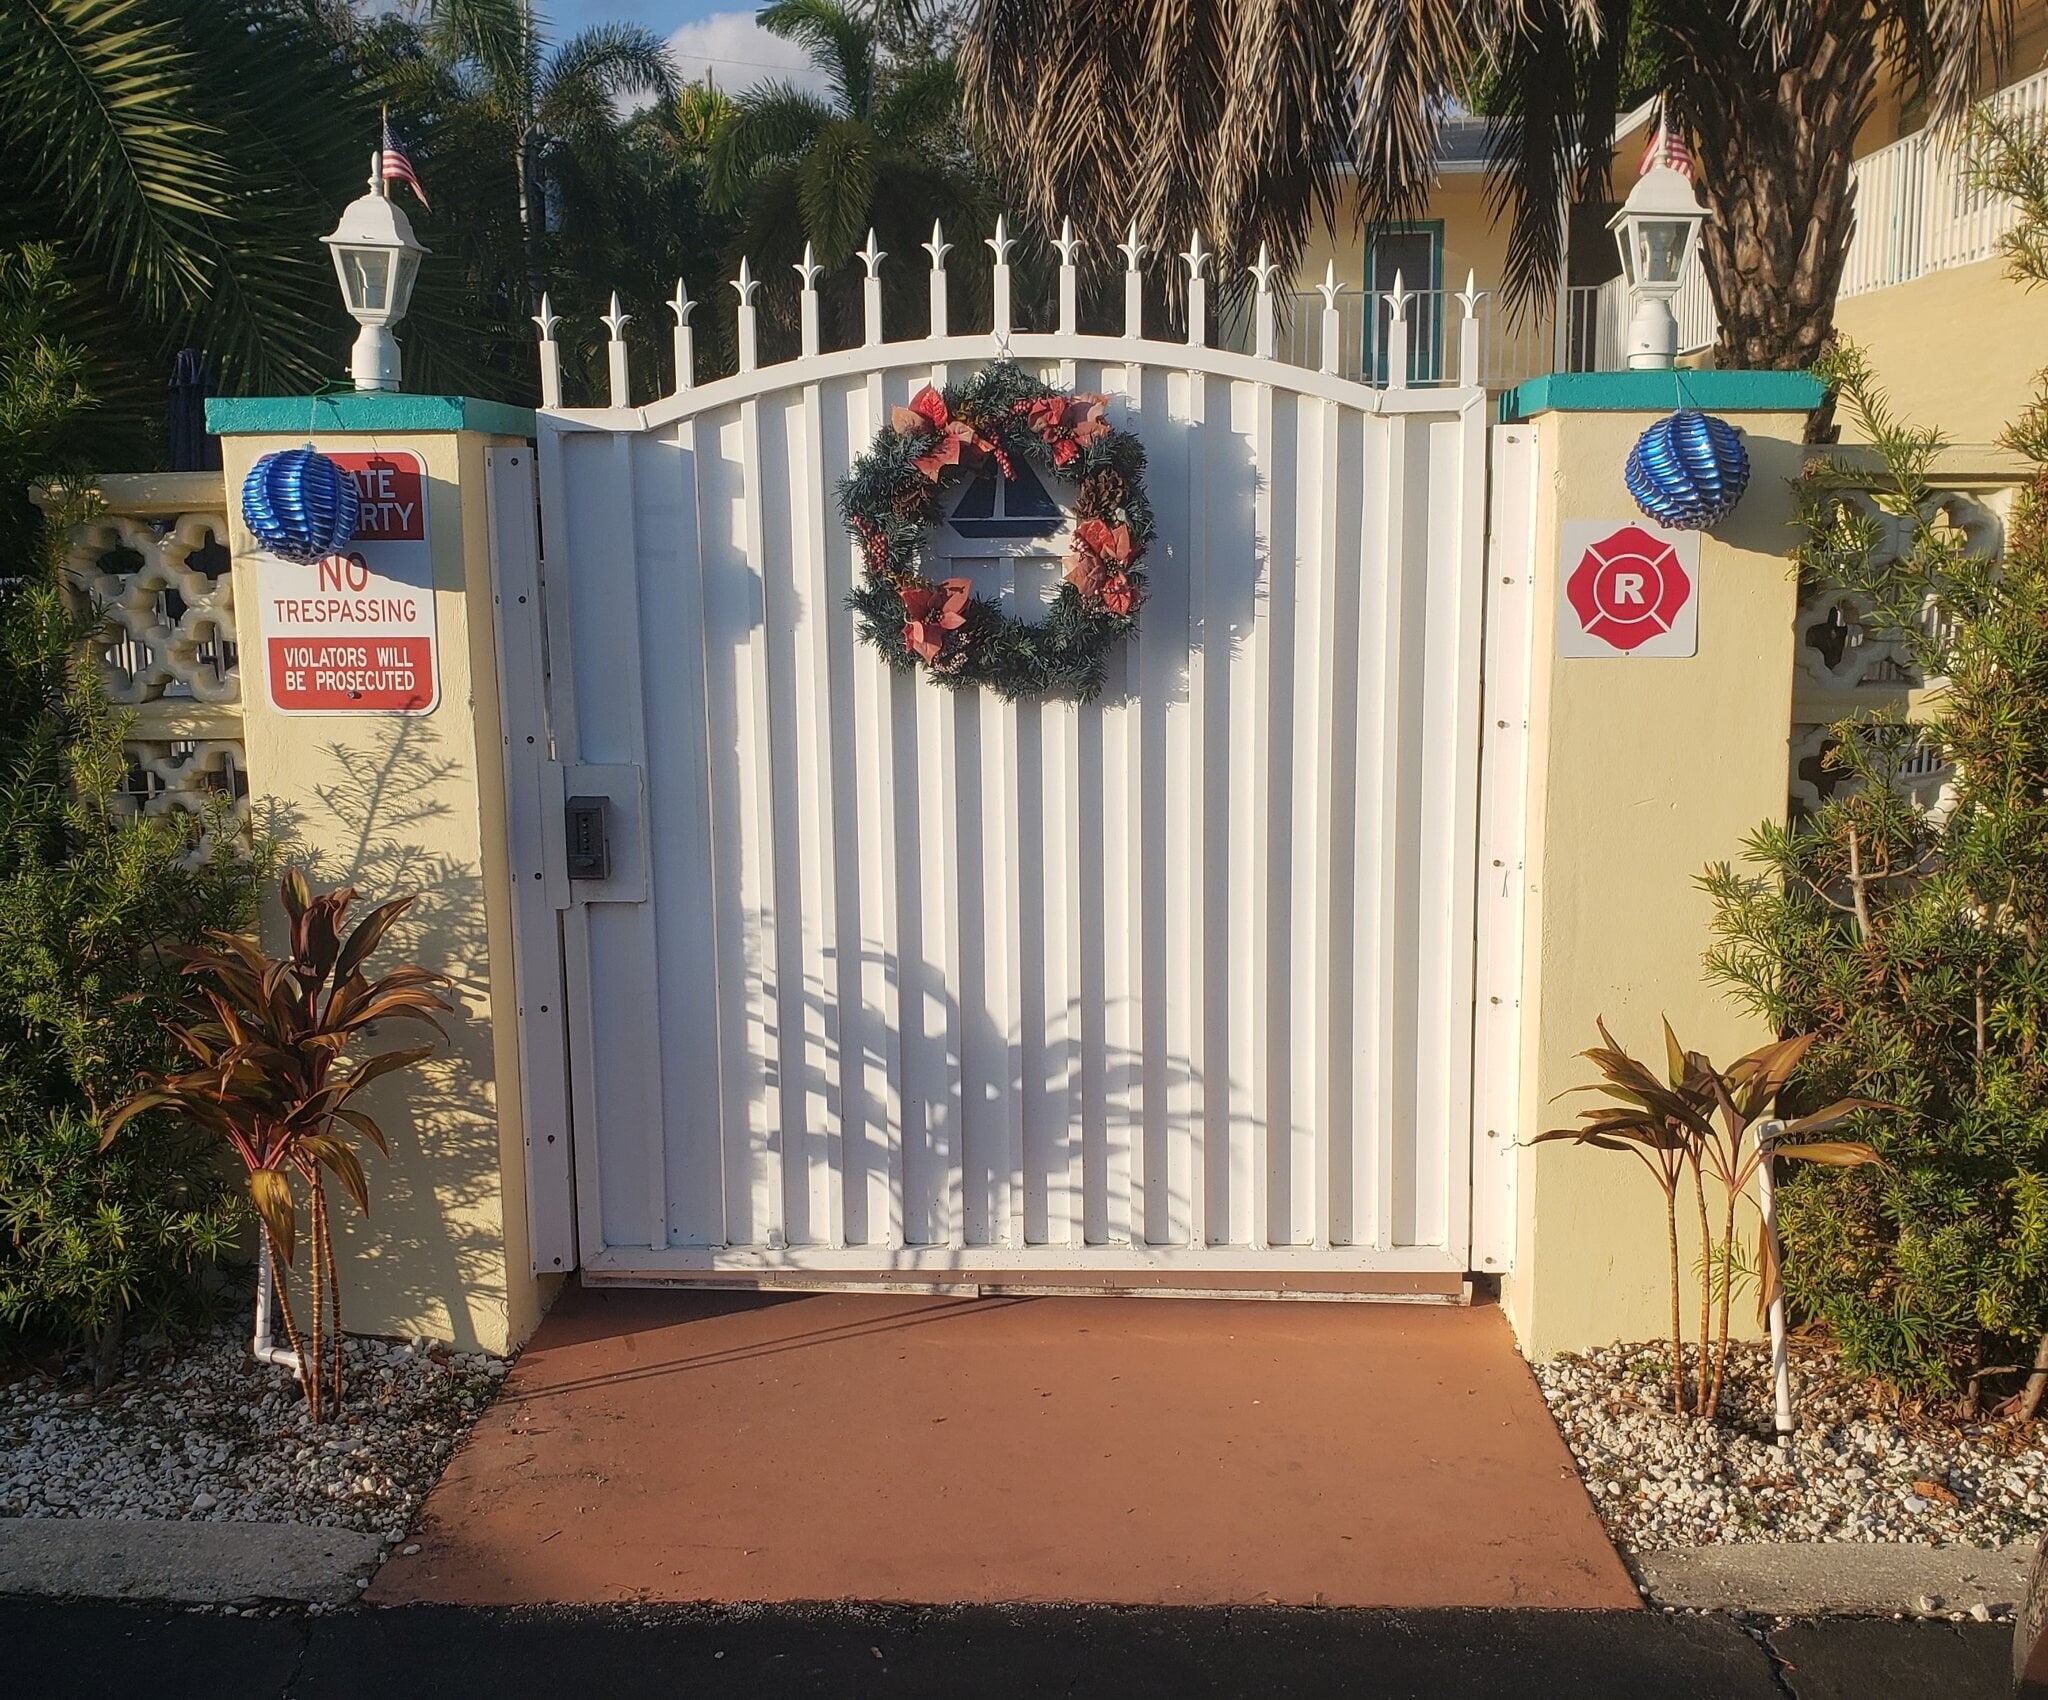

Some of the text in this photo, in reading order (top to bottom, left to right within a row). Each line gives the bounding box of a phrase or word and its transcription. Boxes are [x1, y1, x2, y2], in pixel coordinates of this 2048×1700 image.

[318, 551, 368, 592] NO
[1614, 573, 1645, 605] R
[273, 599, 416, 623] TRESPASSING
[283, 647, 414, 668] VIOLATORS WILL
[285, 670, 415, 691] BE PROSECUTED
